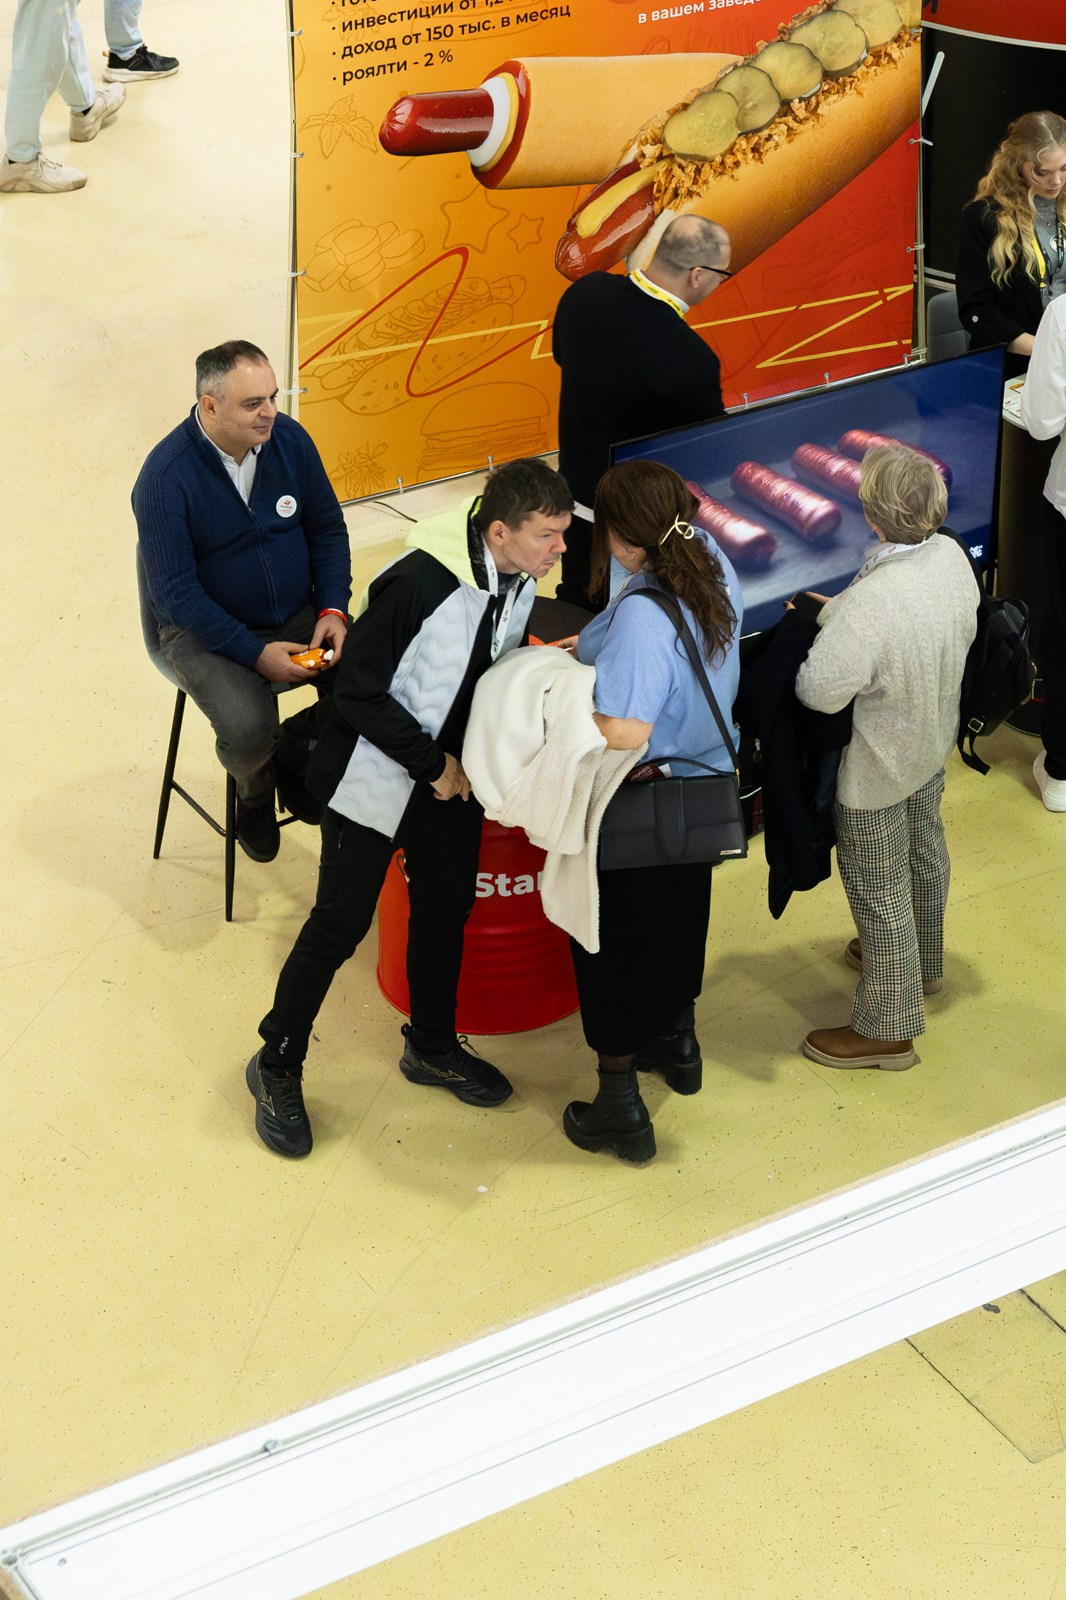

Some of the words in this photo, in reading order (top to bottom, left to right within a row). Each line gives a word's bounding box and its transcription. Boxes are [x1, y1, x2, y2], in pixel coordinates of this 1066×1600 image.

[342, 3, 454, 32] инвестиции
[638, 12, 647, 24] в
[651, 1, 704, 22] вашем
[341, 36, 397, 60] доход
[402, 32, 422, 46] от
[426, 24, 454, 42] 150
[458, 18, 496, 36] тыс.
[501, 15, 511, 28] в
[516, 4, 571, 25] месяц
[342, 60, 408, 86] роялти
[424, 52, 434, 67] 2
[439, 49, 454, 64] %
